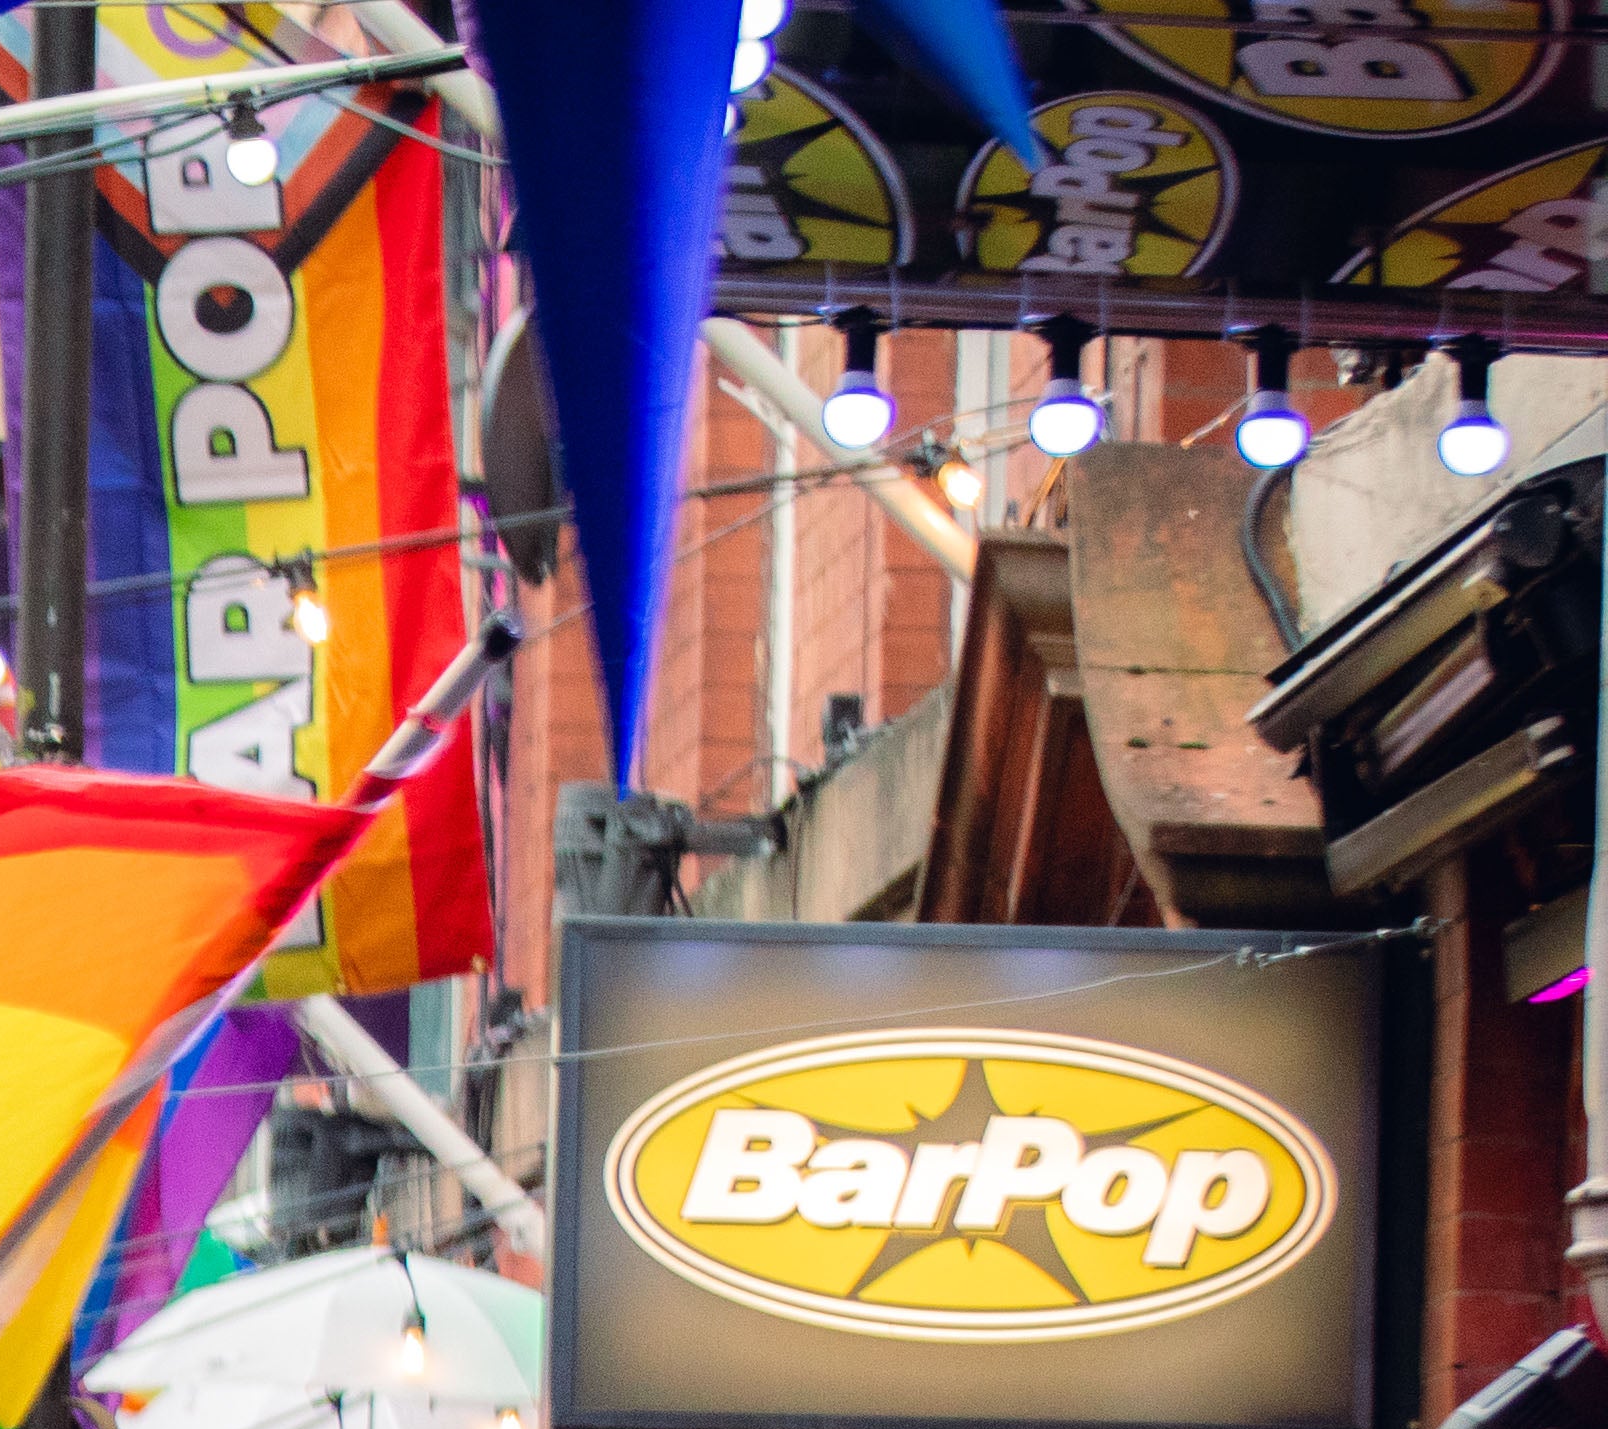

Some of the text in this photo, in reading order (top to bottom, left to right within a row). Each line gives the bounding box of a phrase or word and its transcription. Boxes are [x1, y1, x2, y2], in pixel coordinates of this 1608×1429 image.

[145, 112, 327, 949] AR POP
[680, 1107, 1270, 1269] BarPop
